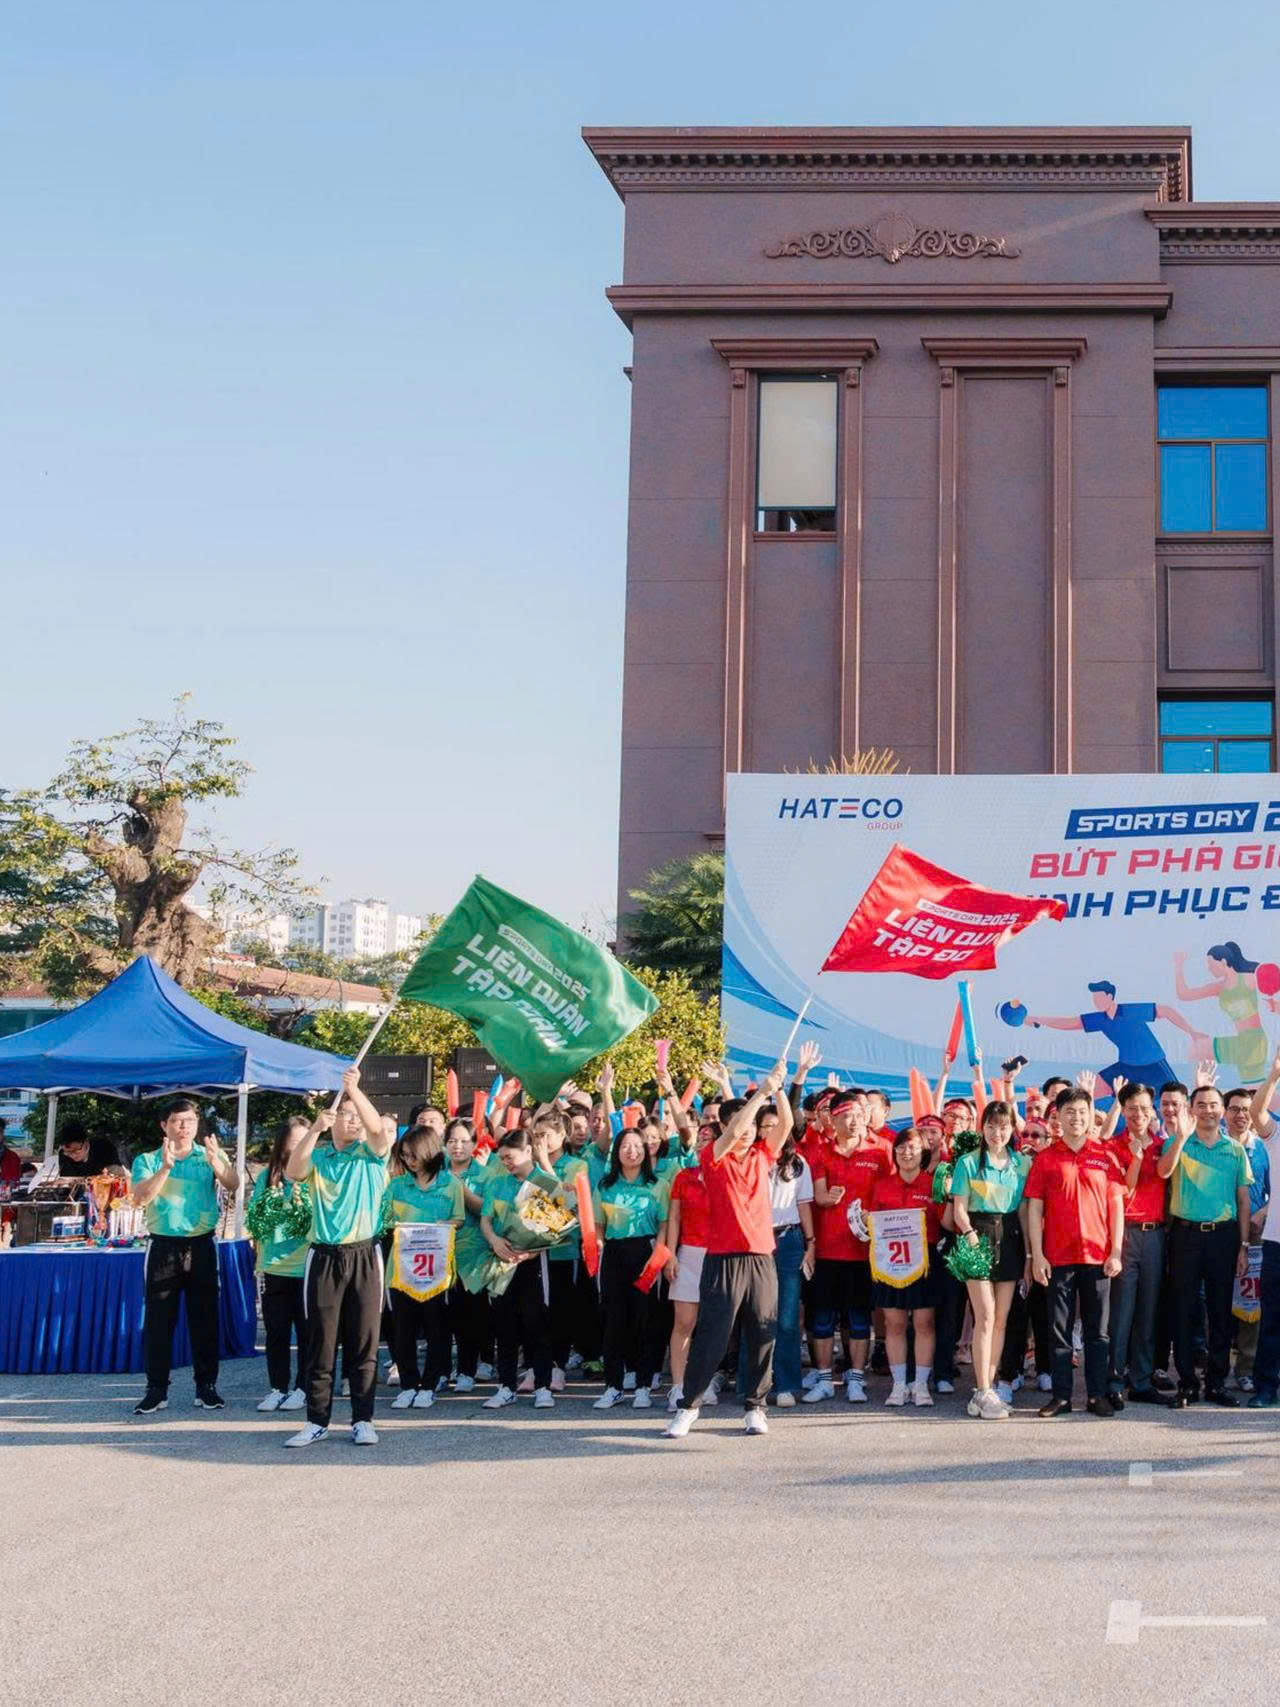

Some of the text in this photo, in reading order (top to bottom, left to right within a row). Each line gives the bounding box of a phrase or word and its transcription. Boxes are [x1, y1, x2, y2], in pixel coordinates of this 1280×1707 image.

[778, 797, 904, 819] HATECO
[1076, 811, 1189, 834] SPORTS
[1193, 808, 1251, 829] DAY
[867, 822, 903, 831] GROUP
[1029, 845, 1117, 879] BỨT
[1127, 841, 1224, 875] PHÁ
[1123, 885, 1251, 920] PHỤC
[884, 908, 956, 944] LIÊN
[981, 913, 1020, 926] 2025
[872, 927, 935, 958] TẬP
[452, 955, 514, 1001] TẬP
[466, 933, 592, 1038] LIÊN QUÂN
[413, 1253, 435, 1277] 21
[888, 1240, 911, 1264] 21
[1240, 1277, 1262, 1299] 21
